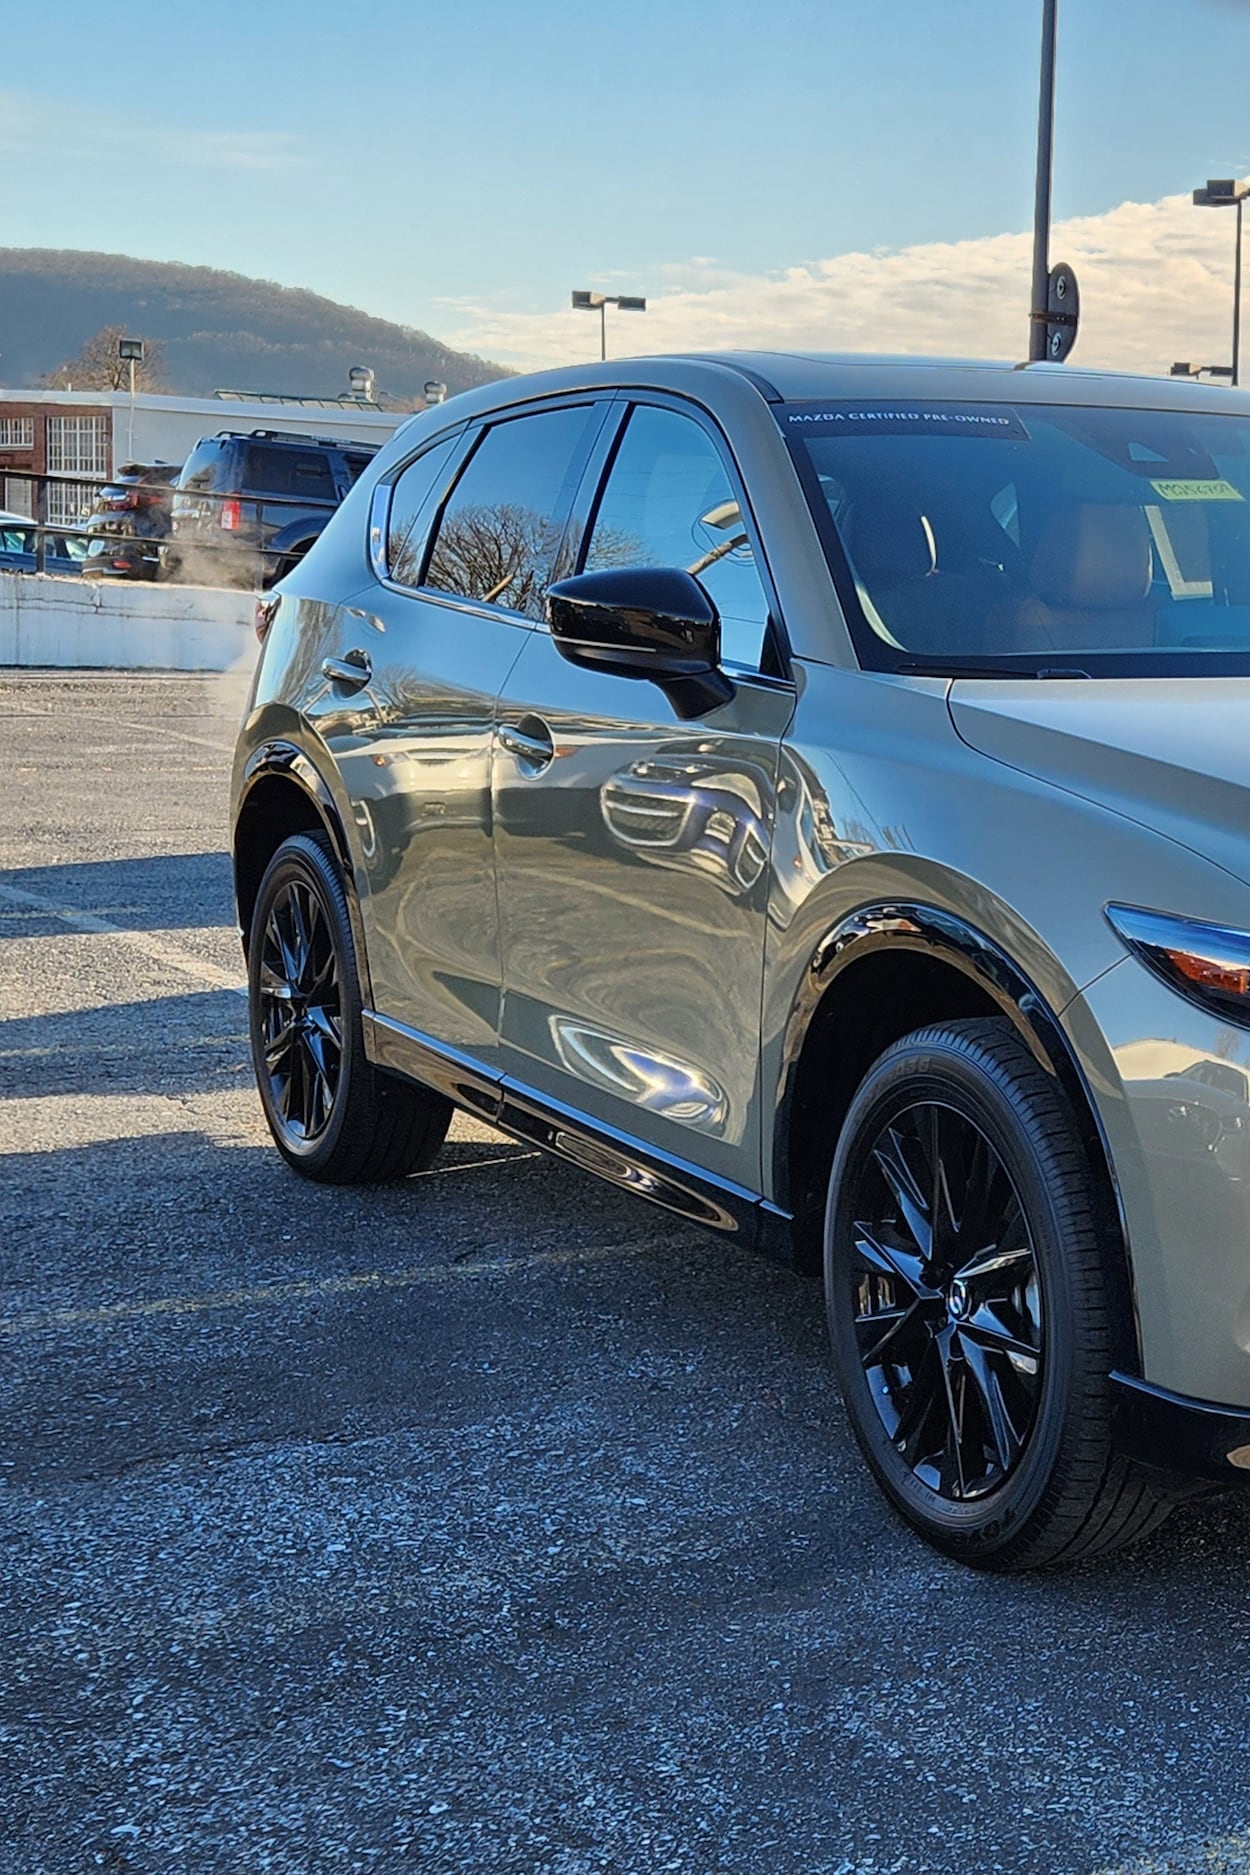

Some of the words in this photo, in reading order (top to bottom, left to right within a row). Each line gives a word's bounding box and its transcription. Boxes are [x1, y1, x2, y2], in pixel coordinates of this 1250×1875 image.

[789, 413, 845, 422] MAZDA
[848, 412, 919, 420] CERTIFIED
[923, 413, 1009, 425] PRE-OWNED
